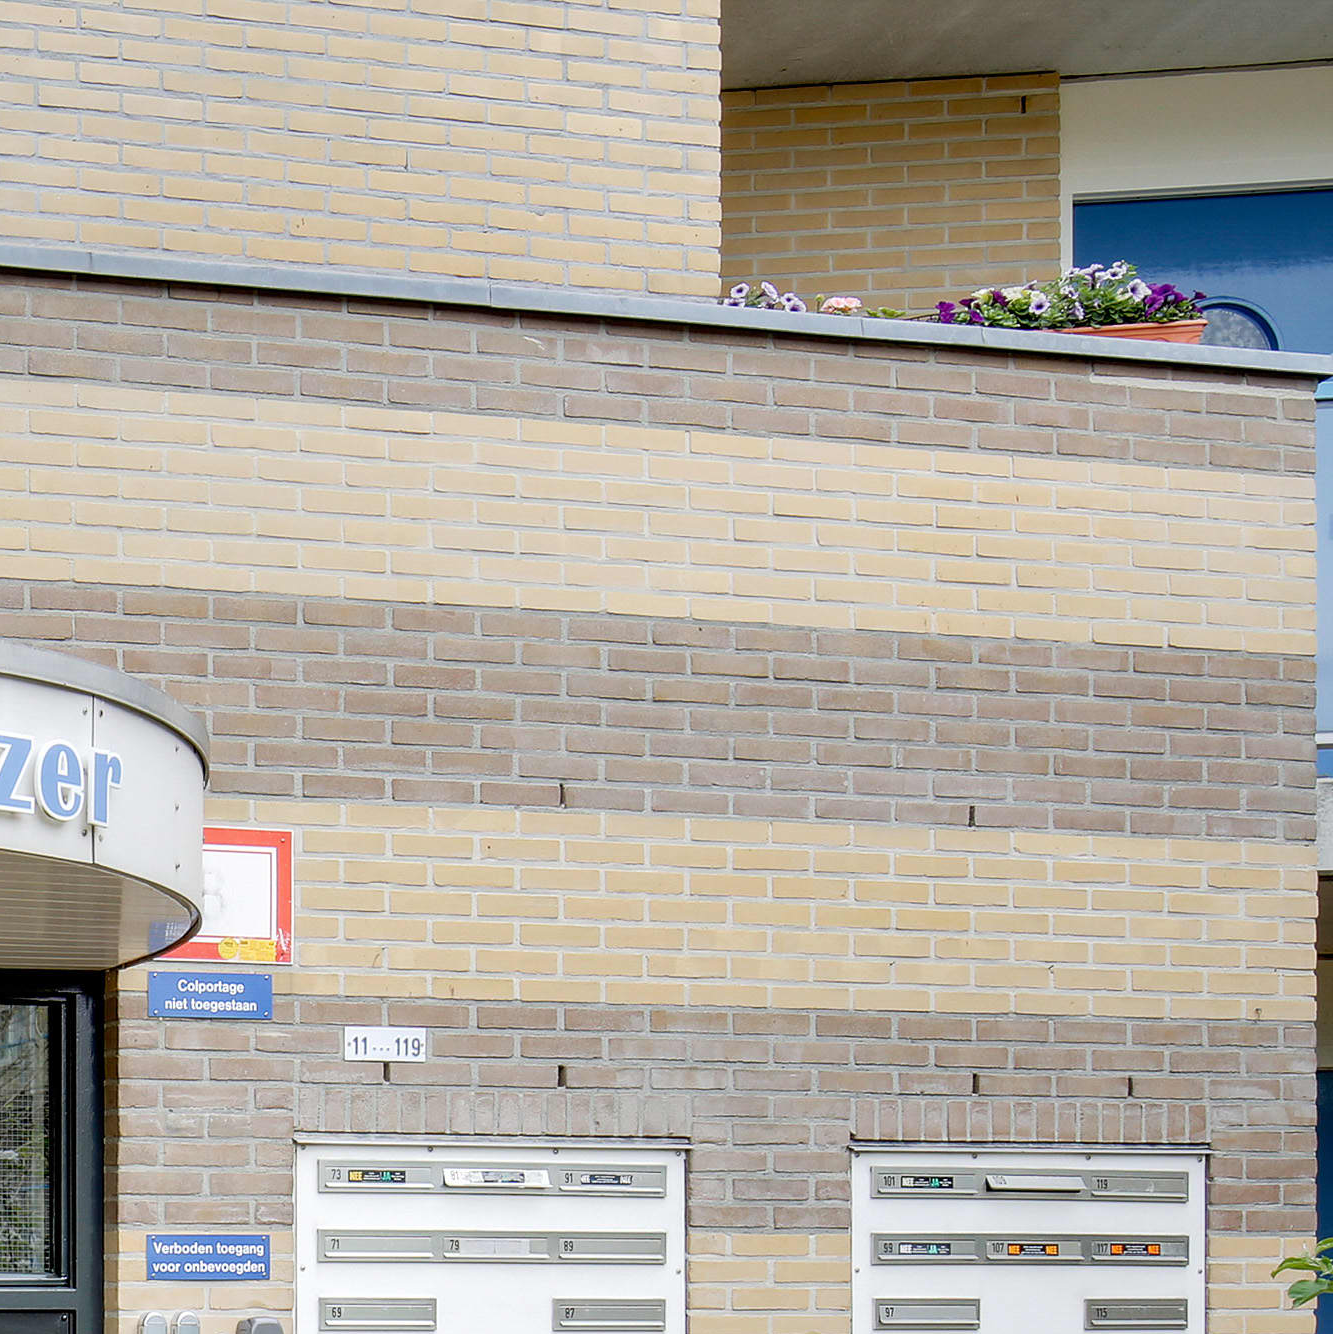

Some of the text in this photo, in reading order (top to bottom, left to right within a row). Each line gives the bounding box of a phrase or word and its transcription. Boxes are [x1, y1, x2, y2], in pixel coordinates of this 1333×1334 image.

[177, 979, 245, 996] Colportage
[164, 998, 258, 1015] niet toegestaan
[331, 1169, 341, 1180] 73
[564, 1173, 574, 1184] 91
[883, 1176, 895, 1187] 101
[1096, 1179, 1108, 1189] 119
[153, 1242, 265, 1258] Verboden toegang
[331, 1239, 340, 1250] 71
[449, 1240, 460, 1250] 79
[563, 1241, 573, 1251] 89
[991, 1243, 1004, 1253] 107
[1097, 1243, 1108, 1253] 117
[152, 1261, 266, 1276] voor onbevoegden
[331, 1307, 342, 1318] 69
[565, 1308, 575, 1319] 87
[885, 1307, 894, 1318] 97
[1096, 1307, 1108, 1318] 115
